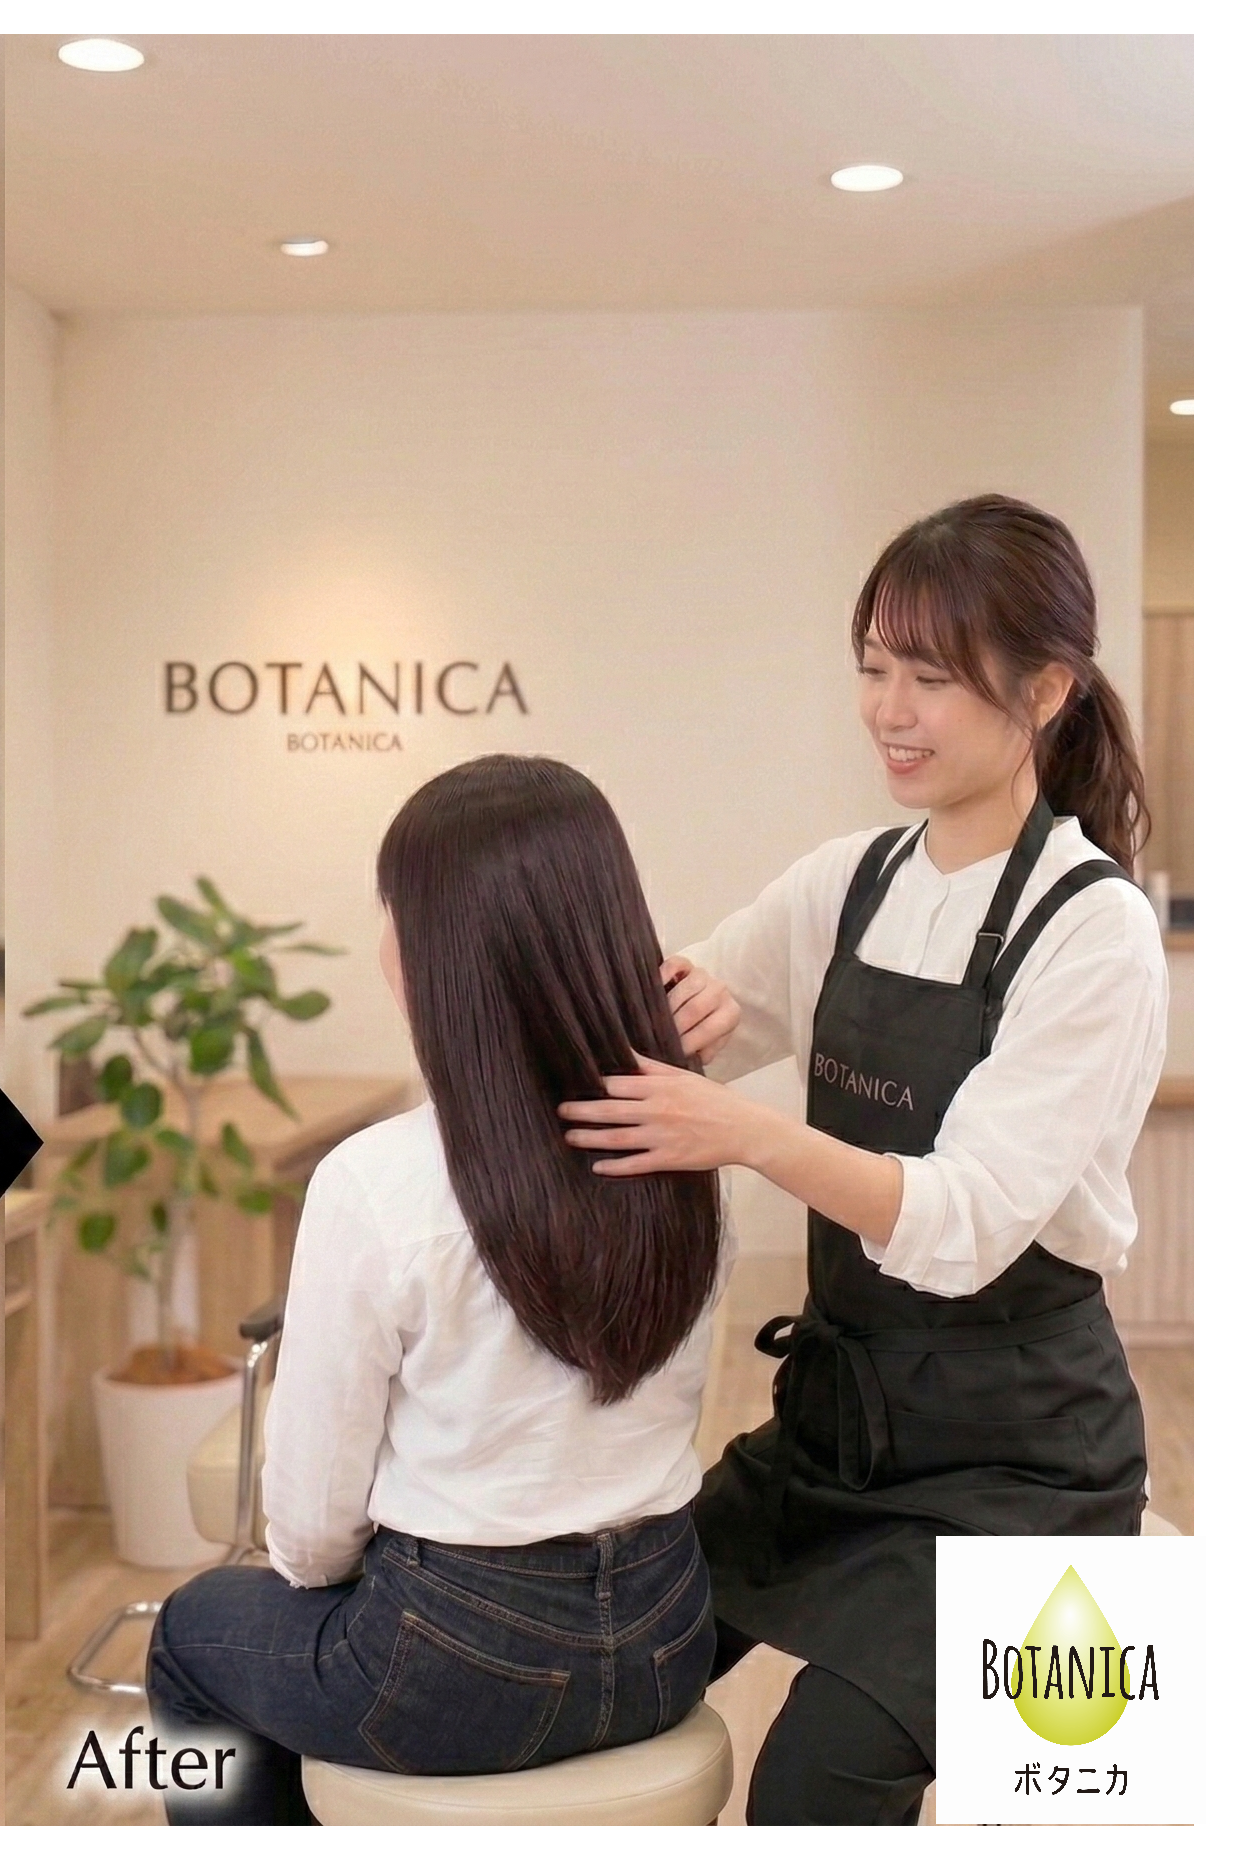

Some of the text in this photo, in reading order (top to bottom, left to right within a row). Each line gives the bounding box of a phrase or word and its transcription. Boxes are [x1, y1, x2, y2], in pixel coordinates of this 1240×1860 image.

[164, 661, 529, 715] BOTANICA
[287, 732, 403, 752] BOTANICA
[814, 1053, 914, 1111] BOTANICA
